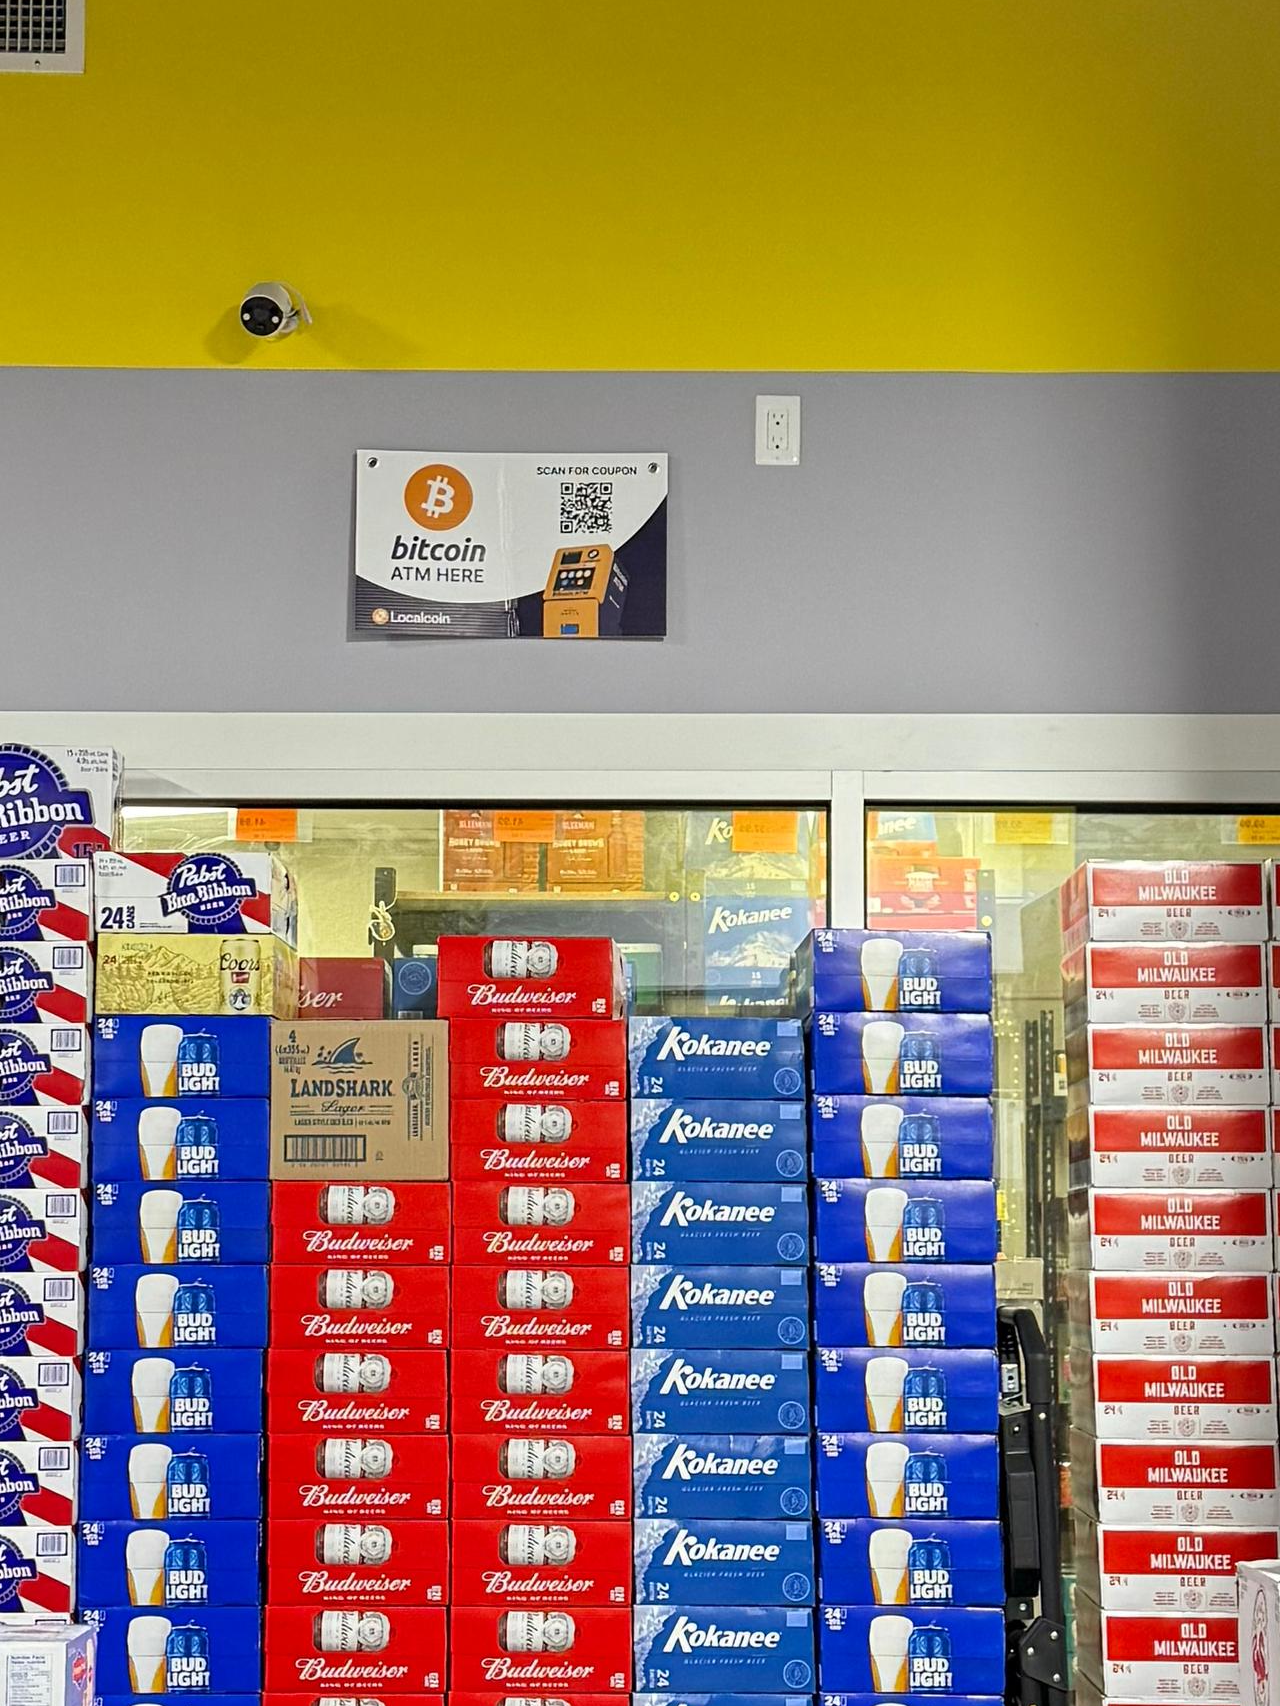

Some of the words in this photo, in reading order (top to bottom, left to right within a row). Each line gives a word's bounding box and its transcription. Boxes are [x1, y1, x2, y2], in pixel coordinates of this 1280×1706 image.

[537, 467, 566, 475] SCAN
[569, 467, 589, 475] FOR
[592, 467, 637, 475] COUPON
[391, 536, 486, 562] bitcoin
[391, 568, 431, 582] ATM
[437, 569, 484, 583] HERE
[390, 611, 450, 625] Localcoin
[177, 863, 227, 888] Pabst
[1164, 870, 1188, 884] OLD
[1138, 886, 1216, 901] MILWAUKEE
[100, 906, 125, 929] 24
[103, 955, 118, 965] 24
[220, 952, 261, 971] Coors
[902, 978, 938, 991] BUD
[468, 984, 576, 1005] Budweiser
[899, 991, 942, 1007] LIGHT
[657, 1025, 772, 1061] Kokanee
[181, 1064, 217, 1077] BUD
[178, 1077, 220, 1093] LIGHT
[1167, 1114, 1192, 1130] OLD
[1141, 1132, 1218, 1146] MILWAUKEE
[303, 1230, 413, 1252] Budweiser
[905, 1229, 942, 1242] BUD
[902, 1242, 946, 1257] LIGHT
[661, 1274, 774, 1309] Kokanee
[176, 1314, 214, 1327] BUD
[173, 1327, 215, 1342] LIGHT
[1171, 1365, 1195, 1380] OLD
[1145, 1383, 1224, 1397] MILWAUKEE
[481, 1400, 592, 1421] Budweiser
[664, 1531, 780, 1565] Kokanee
[296, 1658, 408, 1680] Budweiser
